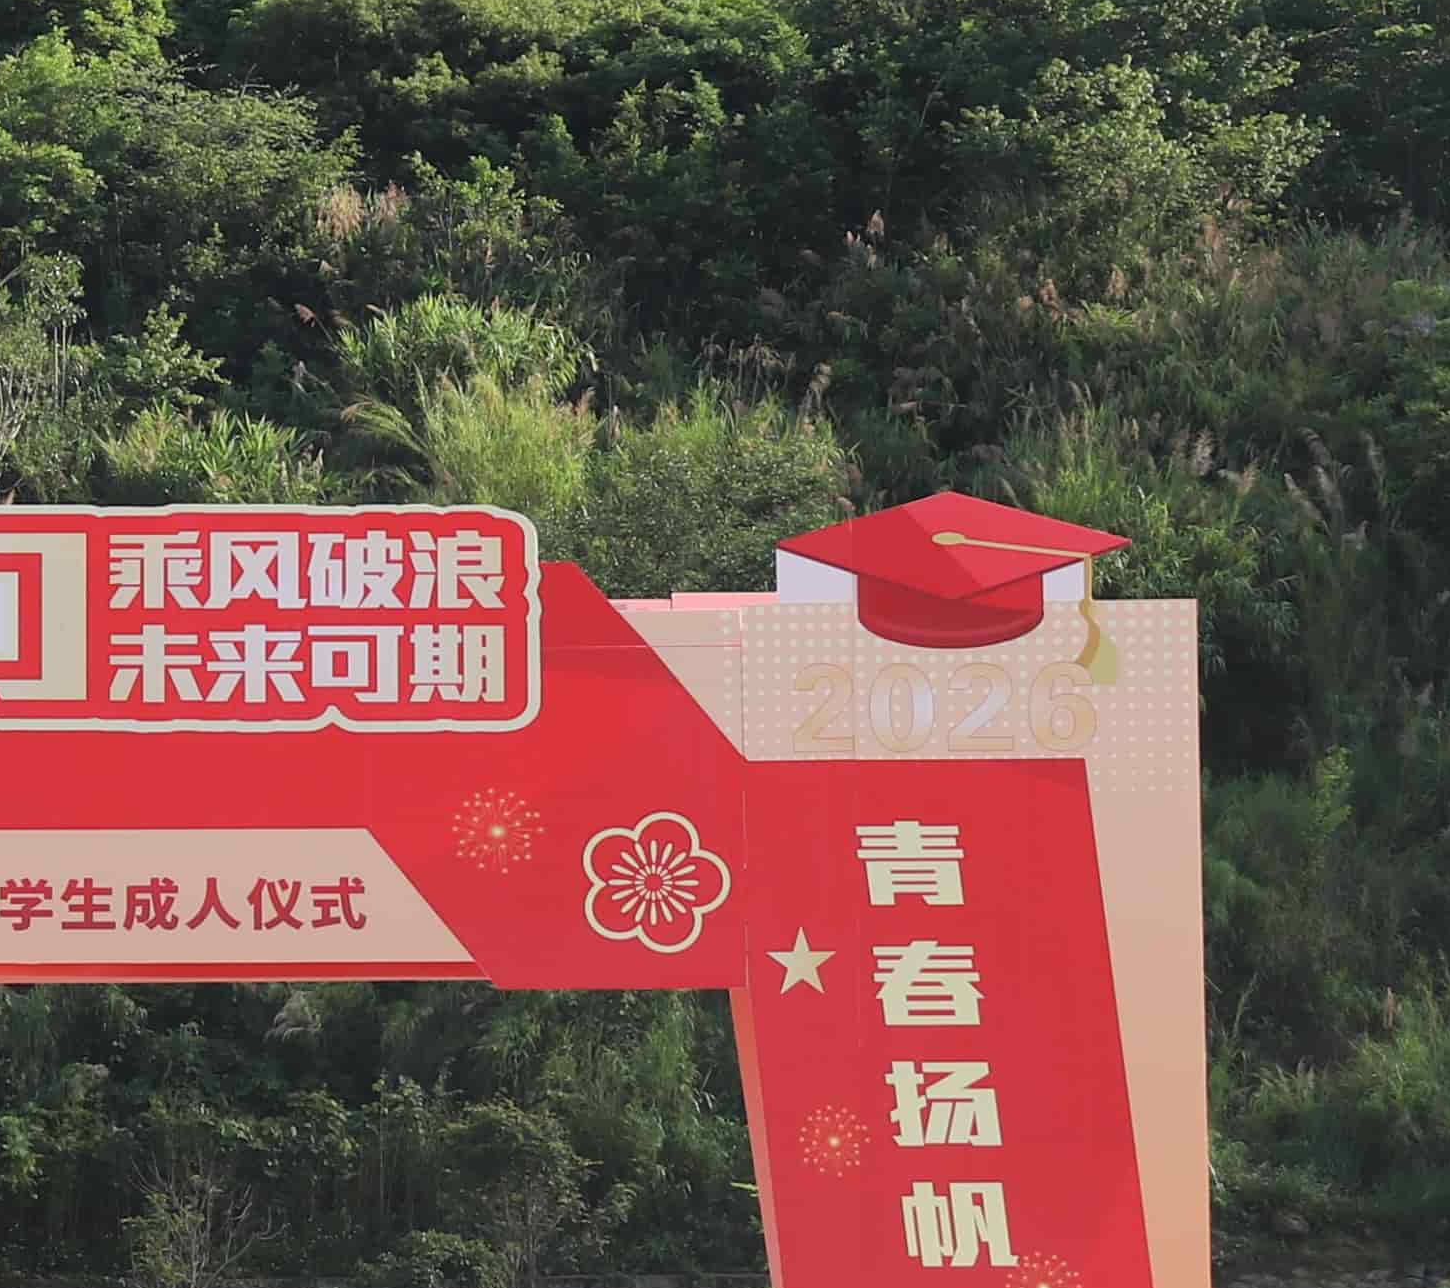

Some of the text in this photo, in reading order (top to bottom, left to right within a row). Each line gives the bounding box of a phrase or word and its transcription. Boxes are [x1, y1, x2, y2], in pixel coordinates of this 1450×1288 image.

[109, 530, 505, 610] 乘风破浪
[109, 623, 506, 703] 未来可期
[792, 662, 1098, 752] 2026
